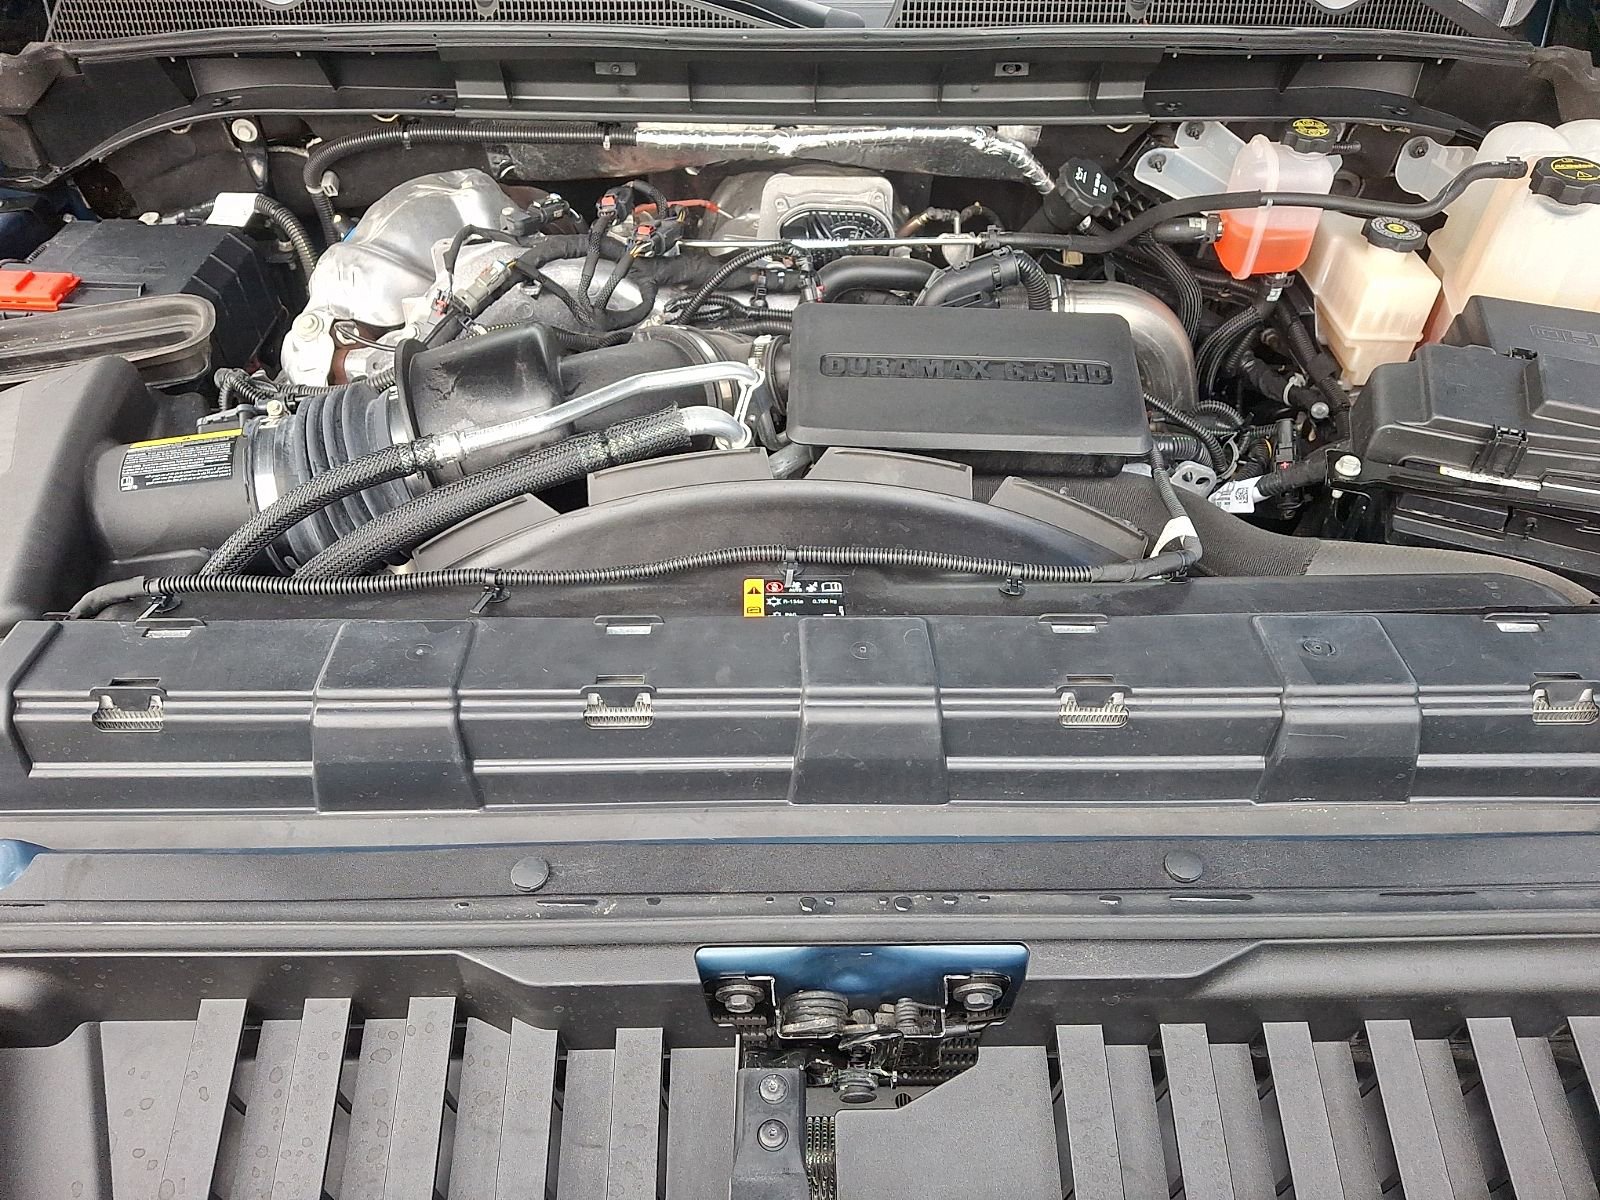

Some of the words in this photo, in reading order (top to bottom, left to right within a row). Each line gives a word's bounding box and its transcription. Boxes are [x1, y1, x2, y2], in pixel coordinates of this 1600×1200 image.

[824, 357, 991, 380] DURAMAX
[1003, 360, 1056, 381] 6.6
[1063, 362, 1110, 384] HD
